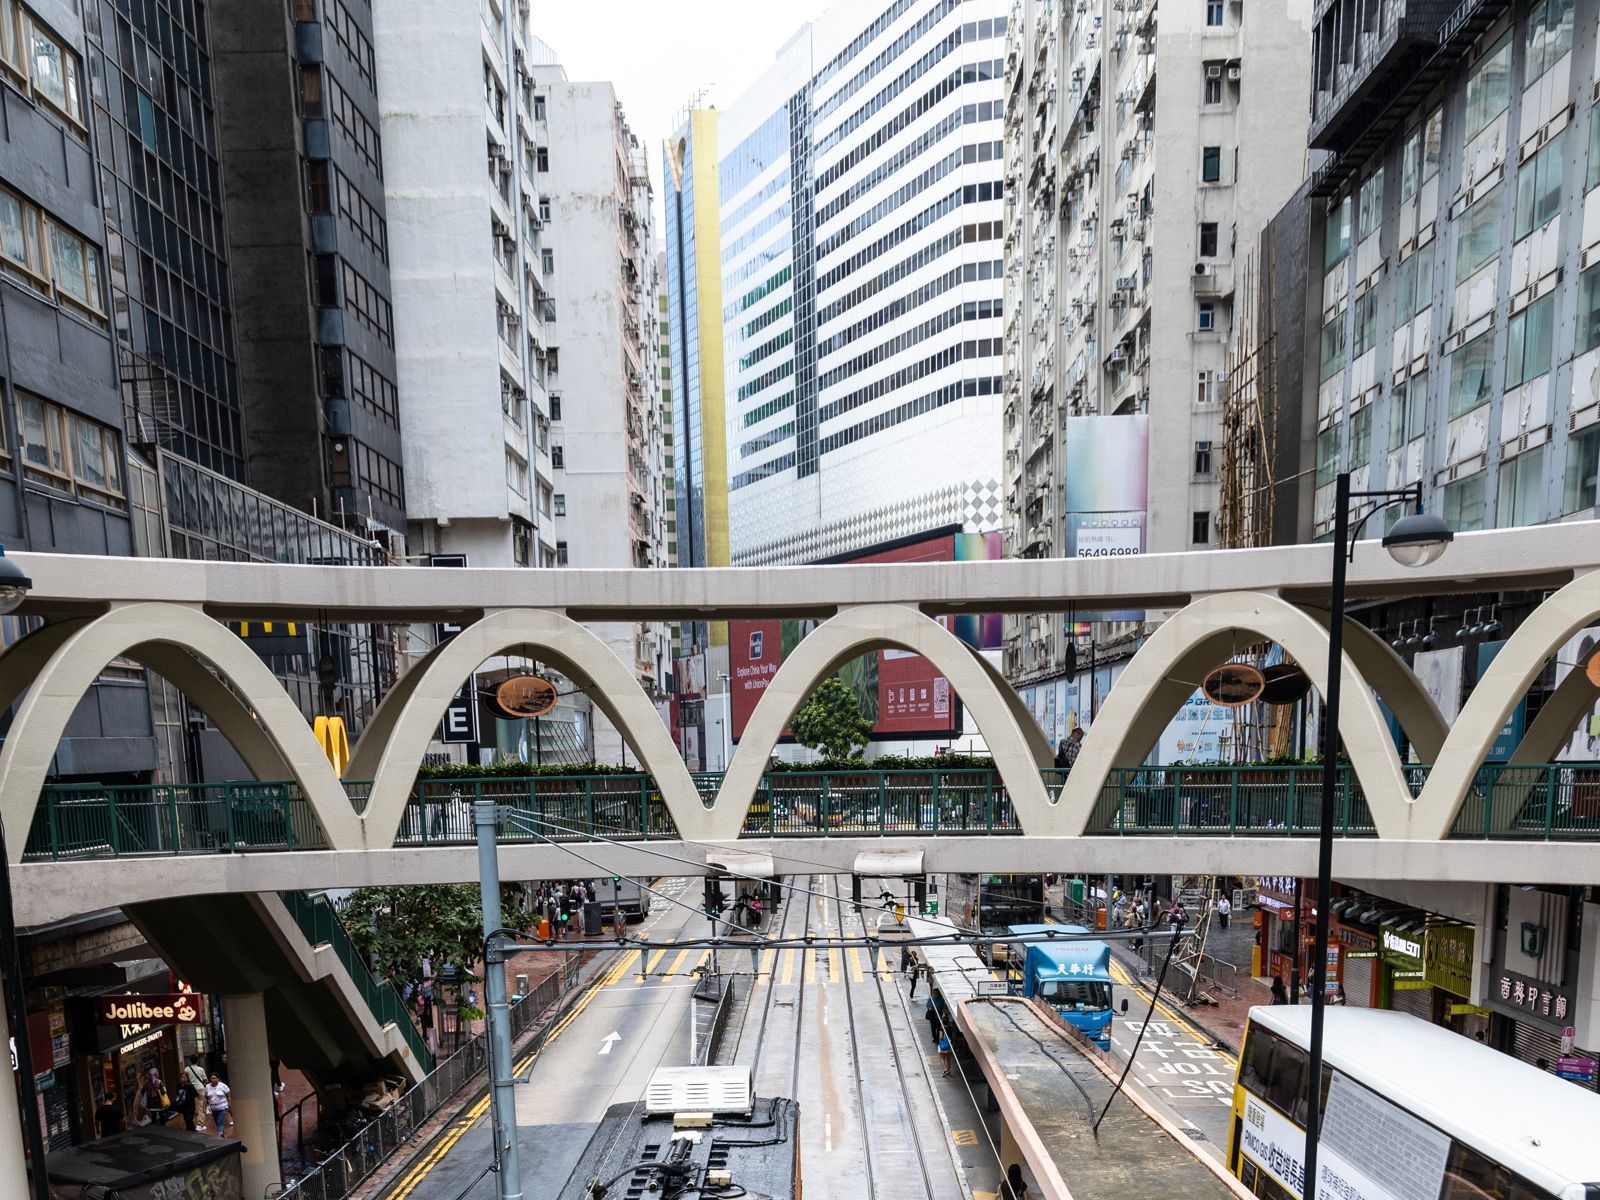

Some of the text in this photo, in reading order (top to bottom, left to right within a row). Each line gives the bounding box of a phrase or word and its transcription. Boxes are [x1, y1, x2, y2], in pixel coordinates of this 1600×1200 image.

[737, 665, 750, 678] Explore
[750, 664, 760, 676] China
[760, 664, 769, 675] Your
[744, 680, 753, 690] with
[1055, 963, 1094, 976] 天華行
[1500, 976, 1568, 1020] 商務印書館
[106, 1002, 174, 1020] Jollibee
[1244, 1129, 1259, 1154] PIMCO
